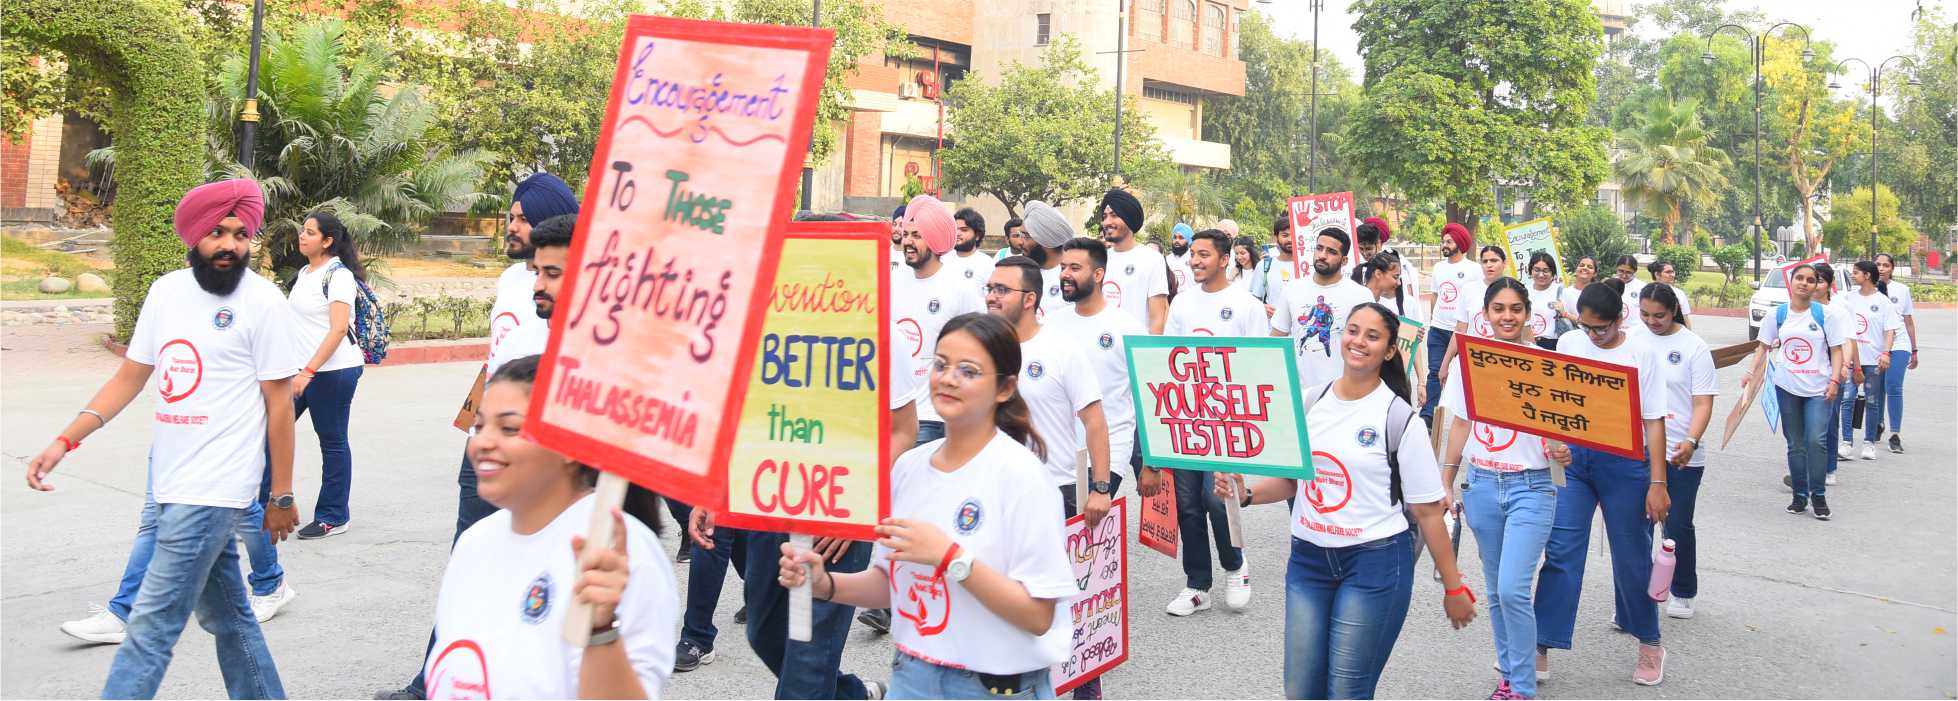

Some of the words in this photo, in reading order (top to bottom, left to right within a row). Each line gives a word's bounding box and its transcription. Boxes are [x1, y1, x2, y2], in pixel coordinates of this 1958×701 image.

[627, 42, 790, 143] Encouragement
[610, 161, 635, 212] To
[1313, 195, 1347, 213] STOP
[570, 230, 732, 363] fighting
[768, 272, 875, 314] vention
[761, 333, 876, 391] BETTER
[1168, 346, 1237, 383] GET
[556, 355, 697, 450] THALASSEMIA
[767, 403, 824, 444] than
[1147, 382, 1275, 422] YOURSELF
[1160, 418, 1265, 458] TESTED
[751, 458, 851, 518] CURE
